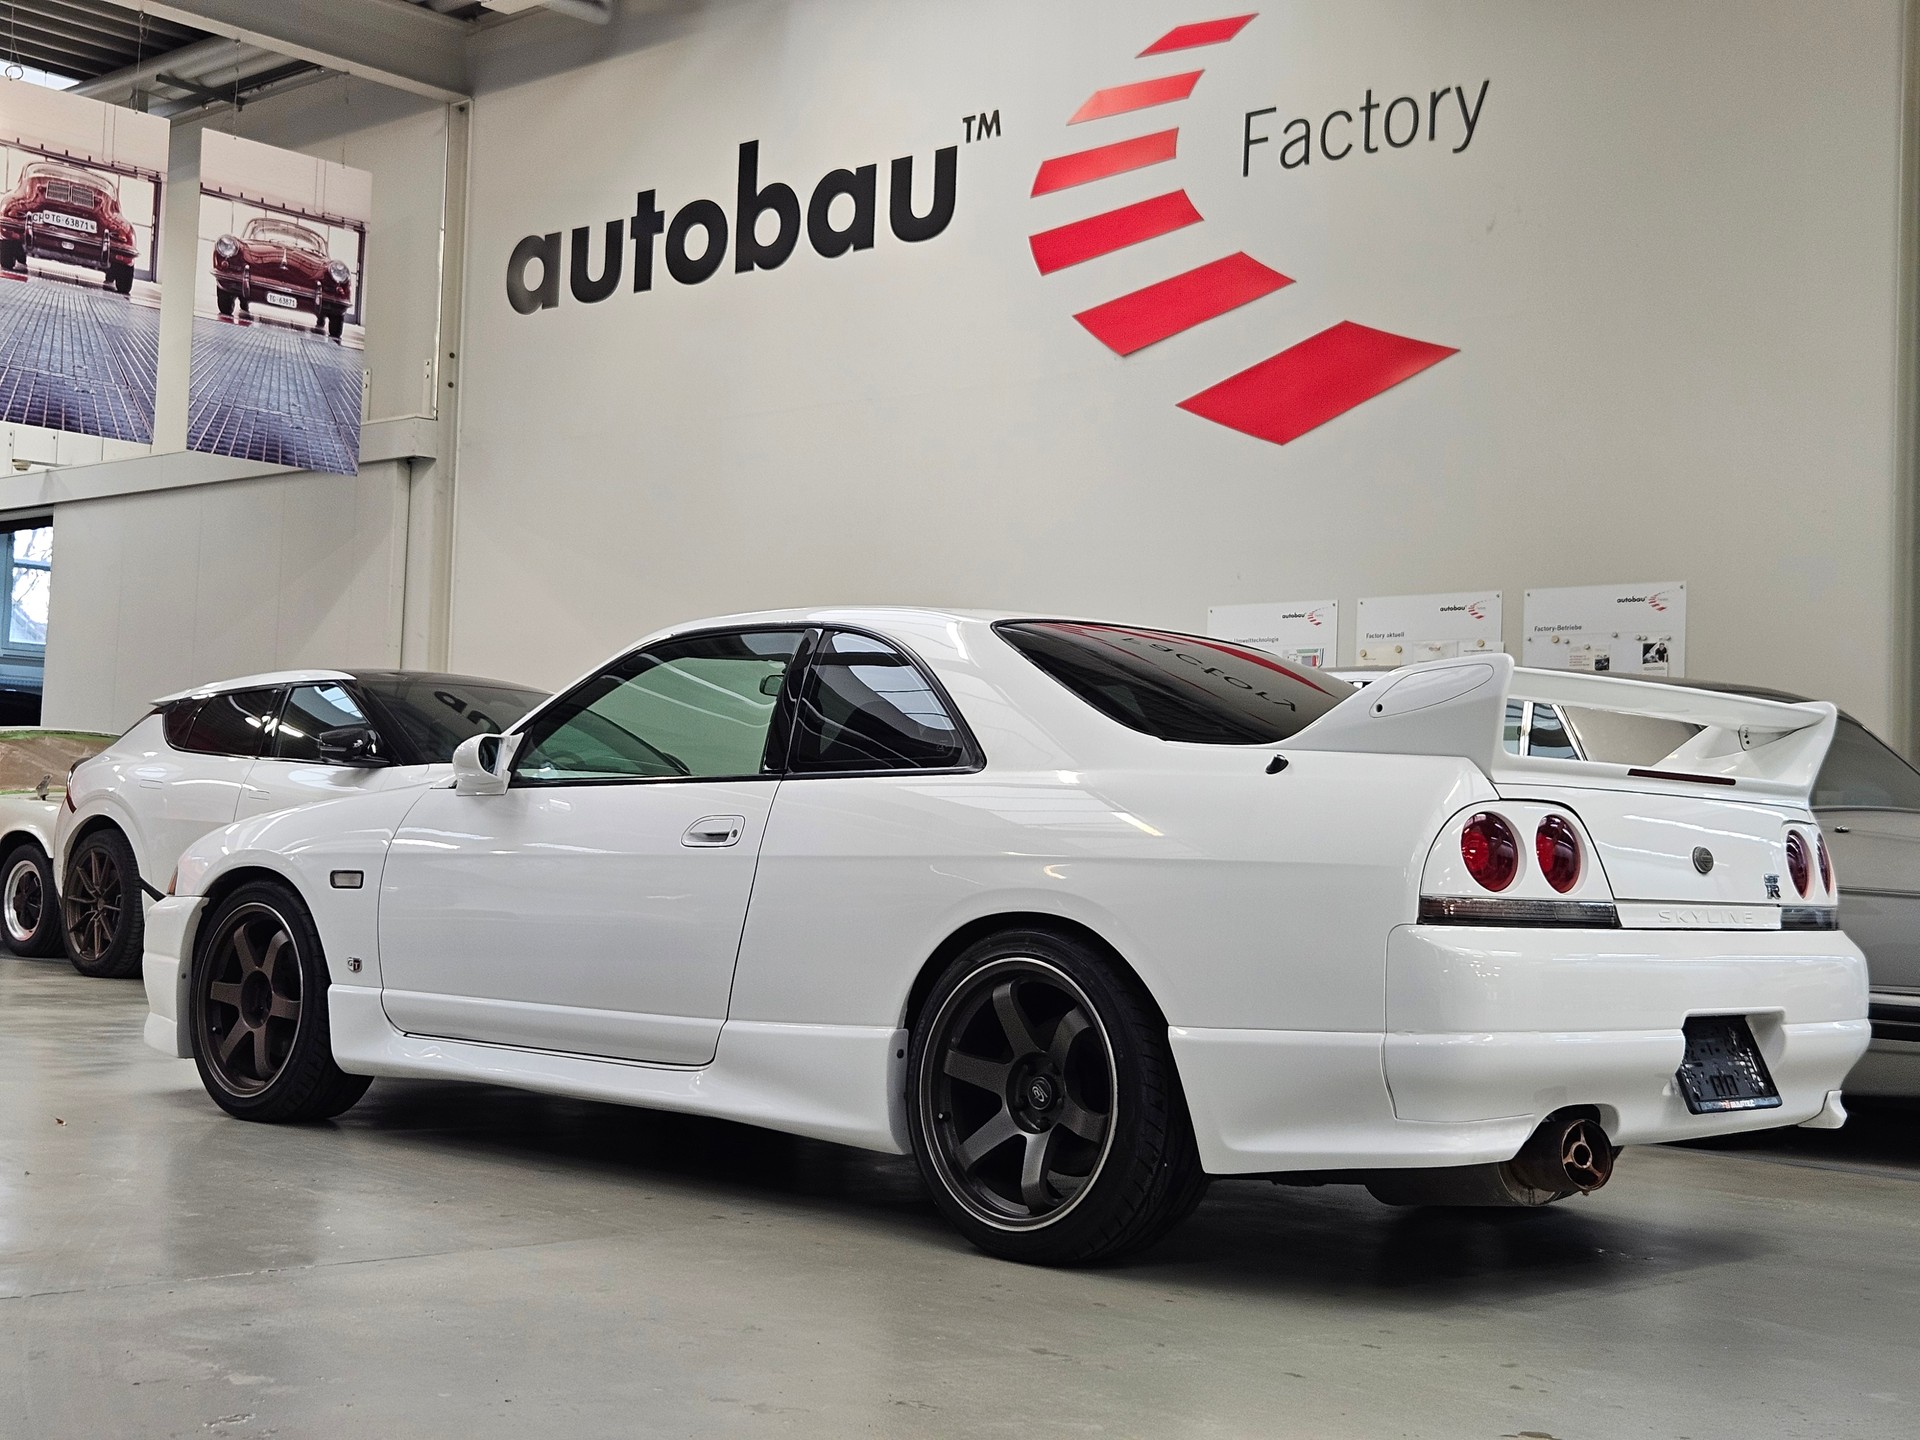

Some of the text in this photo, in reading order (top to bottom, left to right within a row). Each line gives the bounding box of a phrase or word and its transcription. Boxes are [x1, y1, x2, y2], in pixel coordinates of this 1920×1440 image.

[1243, 78, 1490, 177] Factory
[506, 110, 1001, 315] autobau TM
[1616, 596, 1646, 604] autobau
[1439, 604, 1466, 612] autobau
[1534, 624, 1582, 632] Factory-Betriebe
[1365, 632, 1385, 640] Factory
[1658, 910, 1754, 924] SKYLINE
